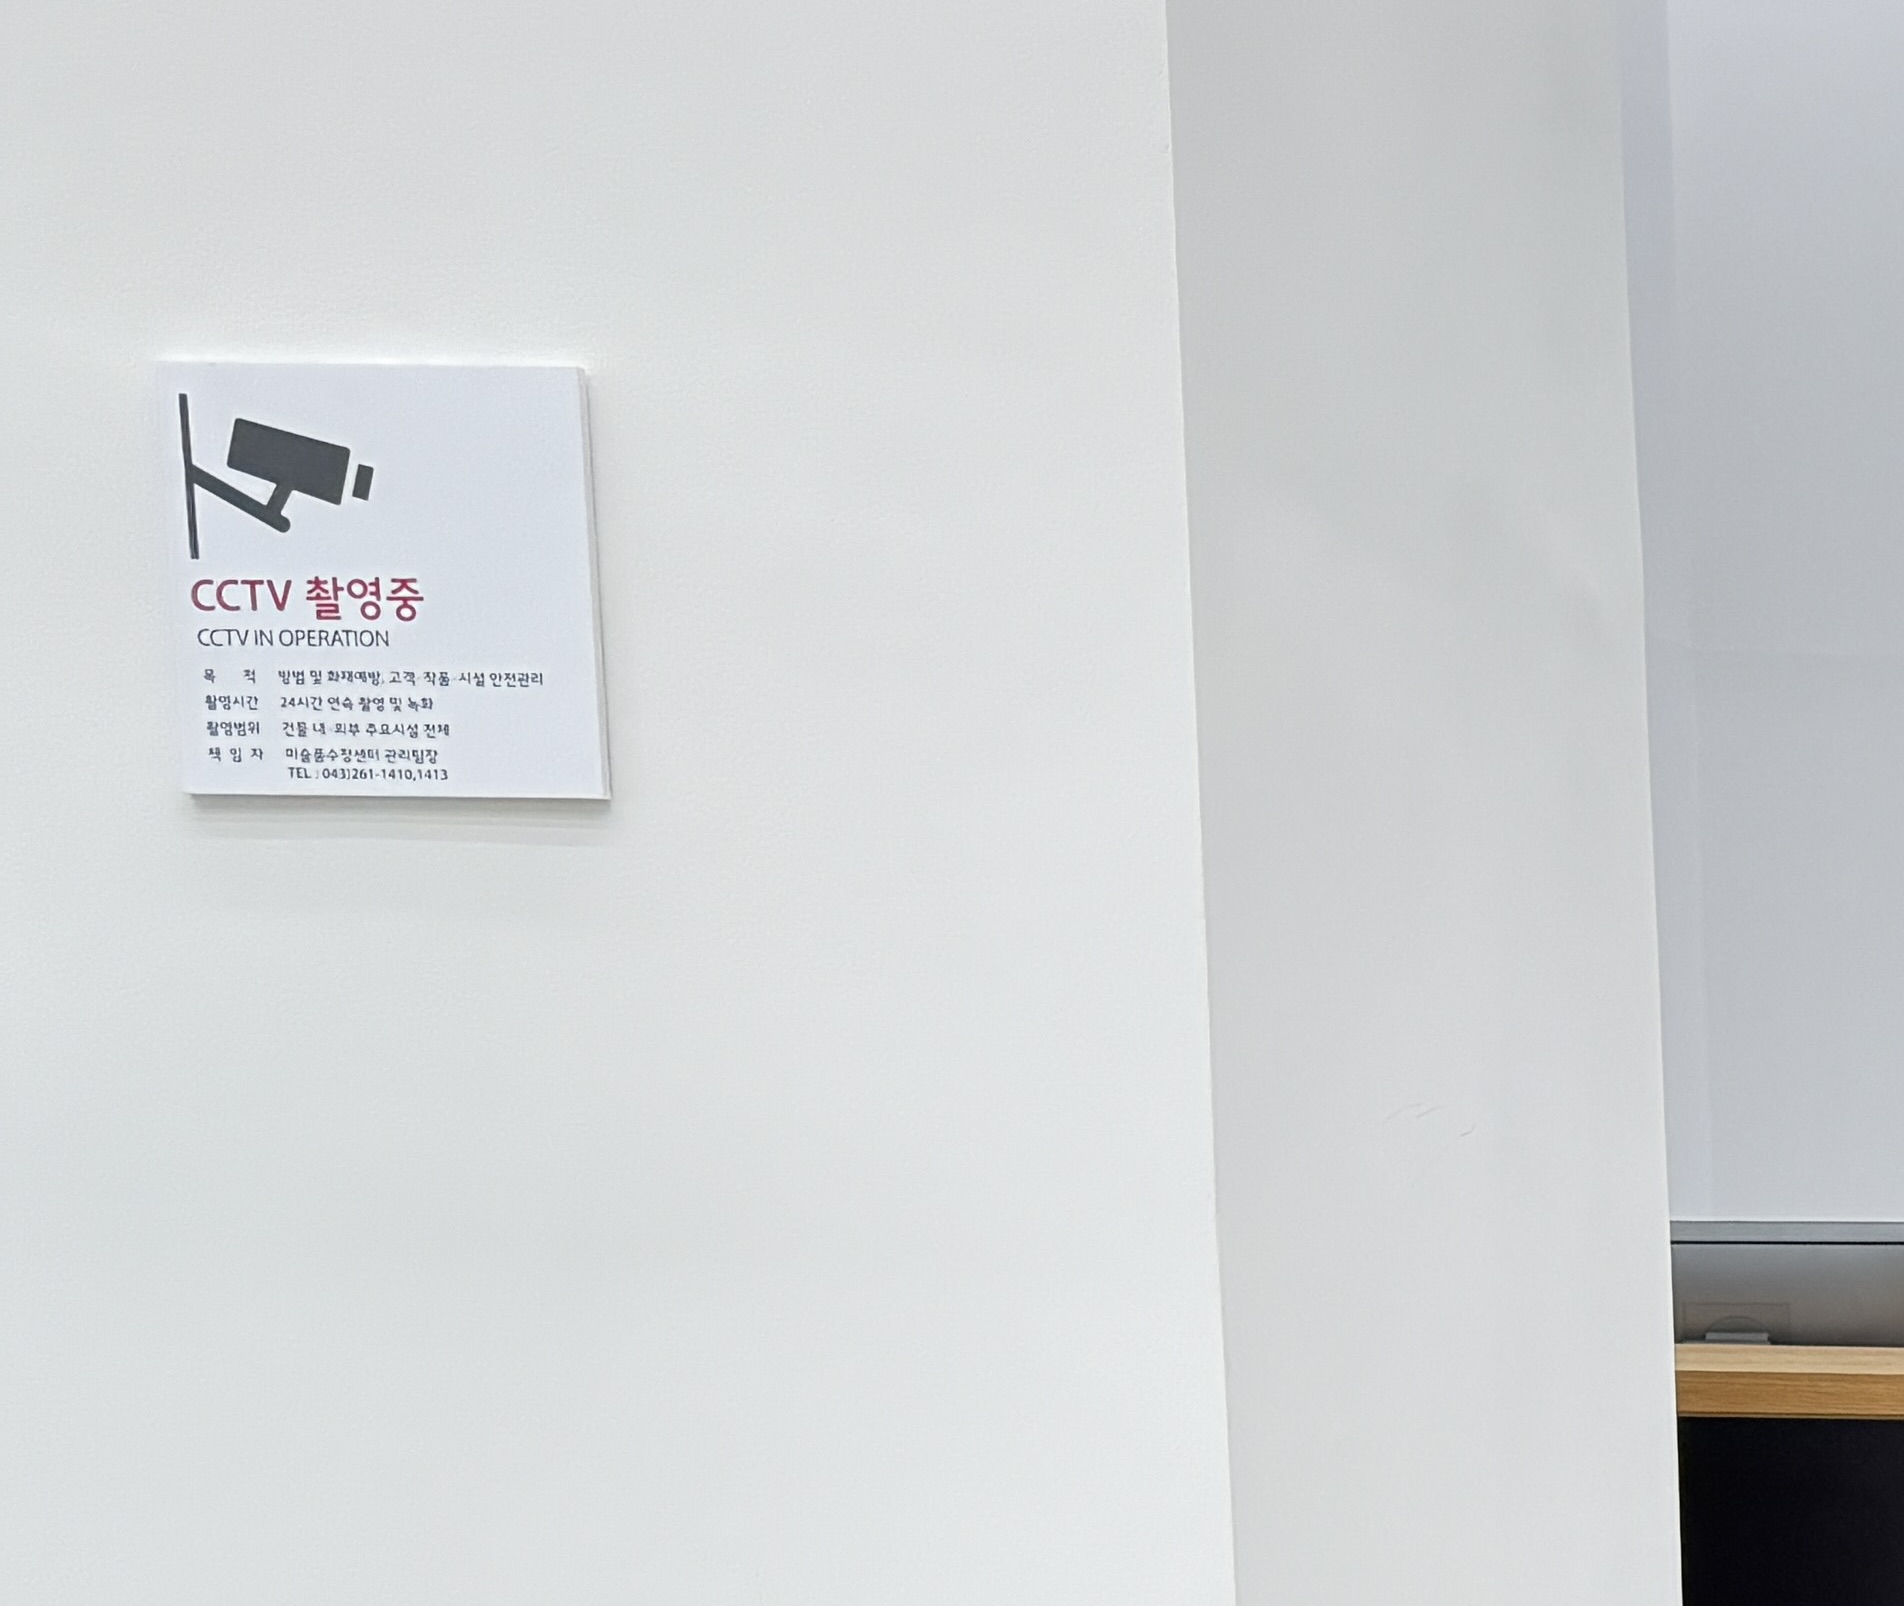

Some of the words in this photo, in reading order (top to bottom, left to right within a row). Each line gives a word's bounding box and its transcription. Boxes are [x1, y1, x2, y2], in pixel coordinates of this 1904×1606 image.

[190, 578, 293, 612] CCTV
[305, 575, 425, 622] 촬영중
[196, 628, 250, 647] CCTV
[253, 629, 274, 647] IN
[278, 629, 390, 648] OPERATION
[488, 672, 544, 688] 안전관리
[204, 694, 259, 711] 촬영시간
[280, 695, 323, 712] 24시간
[357, 696, 385, 713] 촬영
[206, 720, 260, 737] 촬영범위
